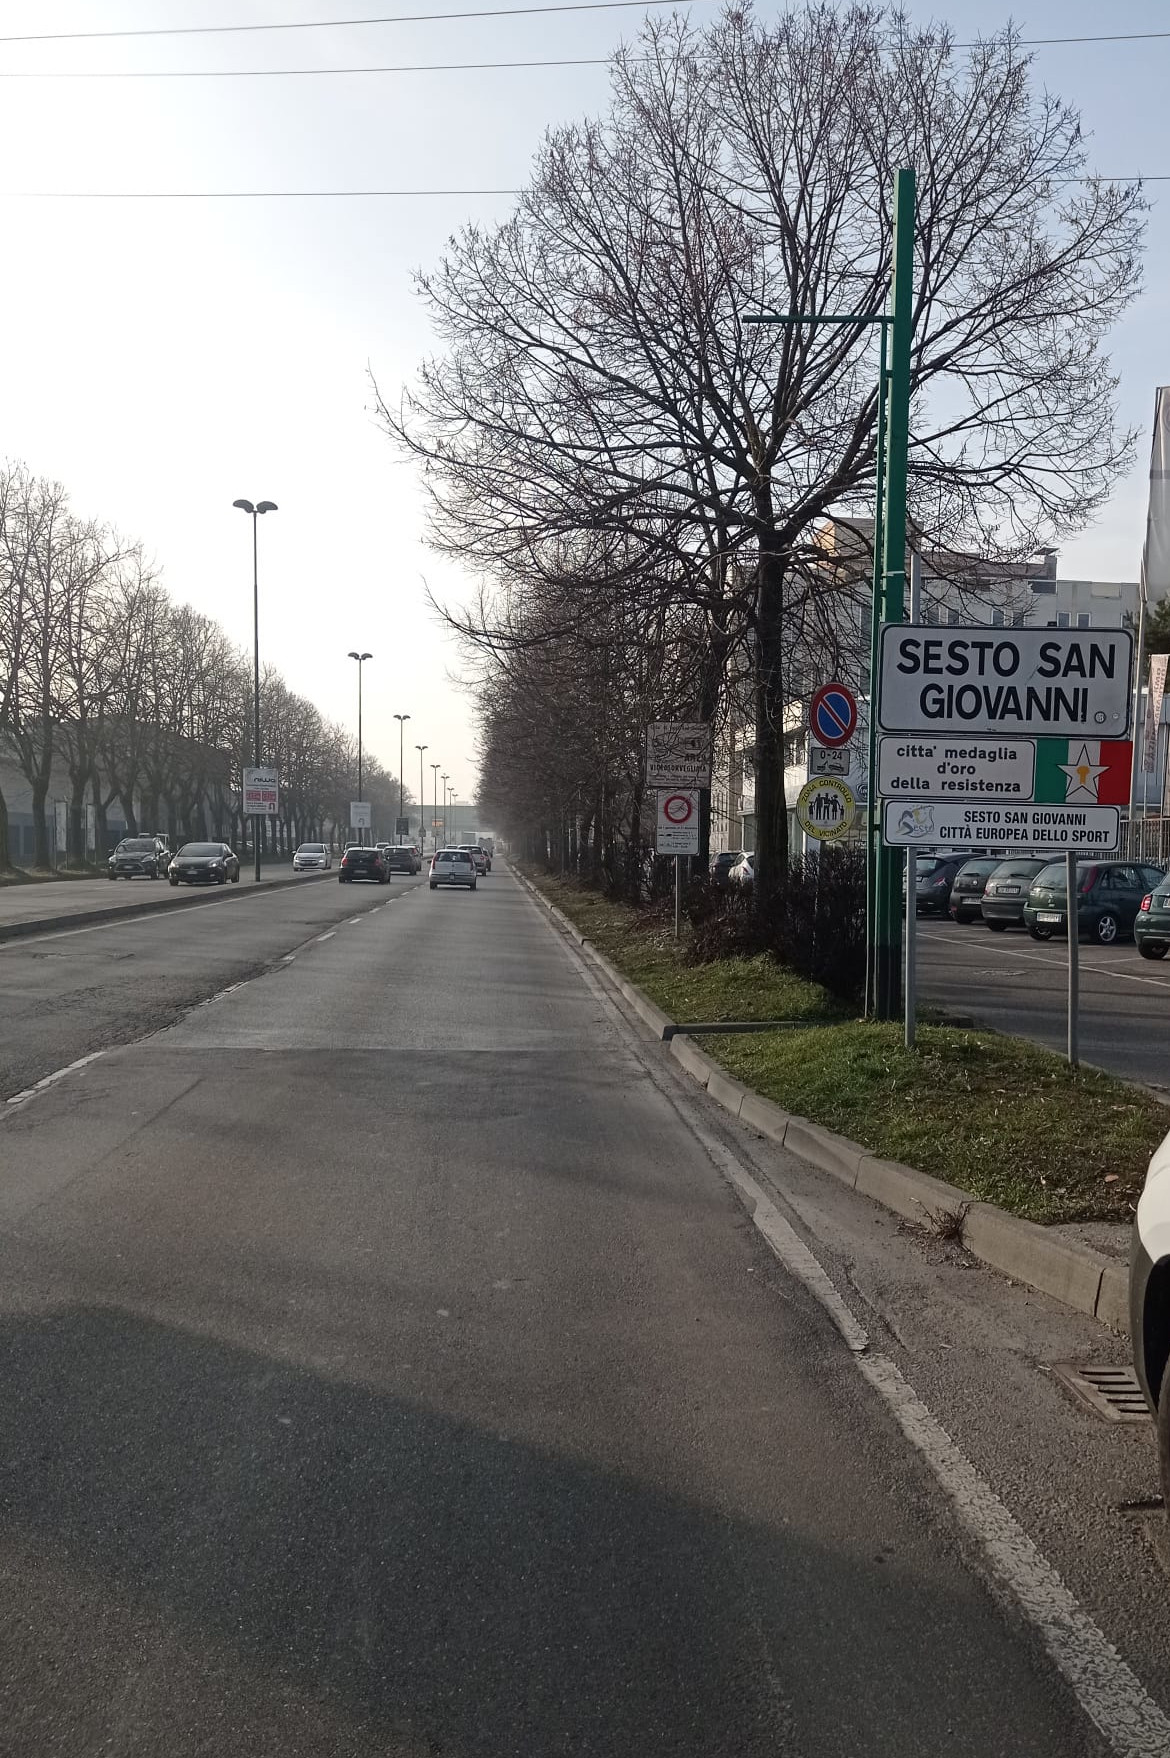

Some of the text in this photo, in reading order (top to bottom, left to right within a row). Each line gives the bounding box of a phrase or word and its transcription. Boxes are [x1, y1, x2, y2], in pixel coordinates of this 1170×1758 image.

[896, 638, 1116, 679] SESTO SAN
[919, 683, 1089, 723] GIOVANNI
[896, 745, 1017, 762] citta' medaglia
[936, 762, 976, 775] d'oro
[801, 784, 817, 802] ZONA
[819, 779, 852, 803] CONTROLLO
[890, 777, 1021, 793] della resistenza
[963, 810, 1086, 826] SESTO SAN GIOVANNI
[804, 820, 848, 837] DEL VICINATO
[939, 823, 1110, 843] CITTÀ EUROPEA DELLO SPORT
